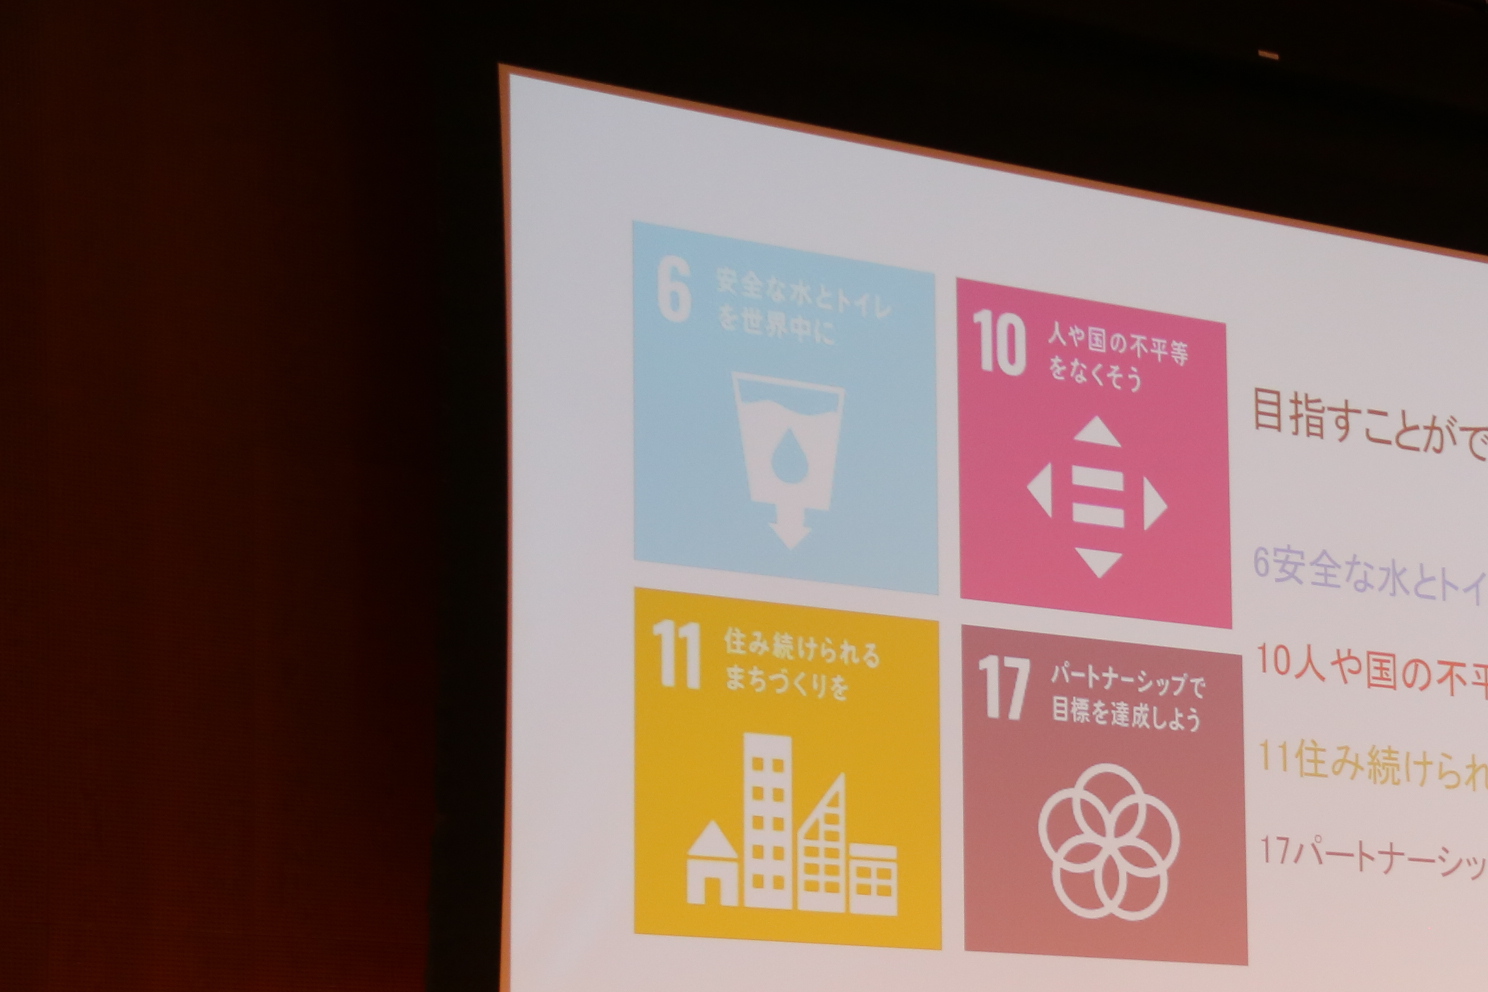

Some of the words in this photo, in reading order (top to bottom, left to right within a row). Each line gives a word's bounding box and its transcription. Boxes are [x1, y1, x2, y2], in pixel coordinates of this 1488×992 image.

[656, 254, 693, 323] 6
[717, 266, 892, 320] 安全な水とトイレ
[717, 303, 837, 346] を世界中に
[972, 308, 1028, 377] 10
[1048, 320, 1189, 367] 人や国の不平等
[1048, 355, 1143, 394] をなくそう
[652, 619, 701, 690] 11
[724, 626, 881, 669] 住み続けられる
[725, 663, 850, 701] まちづくりを
[978, 654, 1032, 721] 17
[1051, 662, 1207, 699] パートナーシップで
[1052, 695, 1203, 734] 目標を達成しよう
